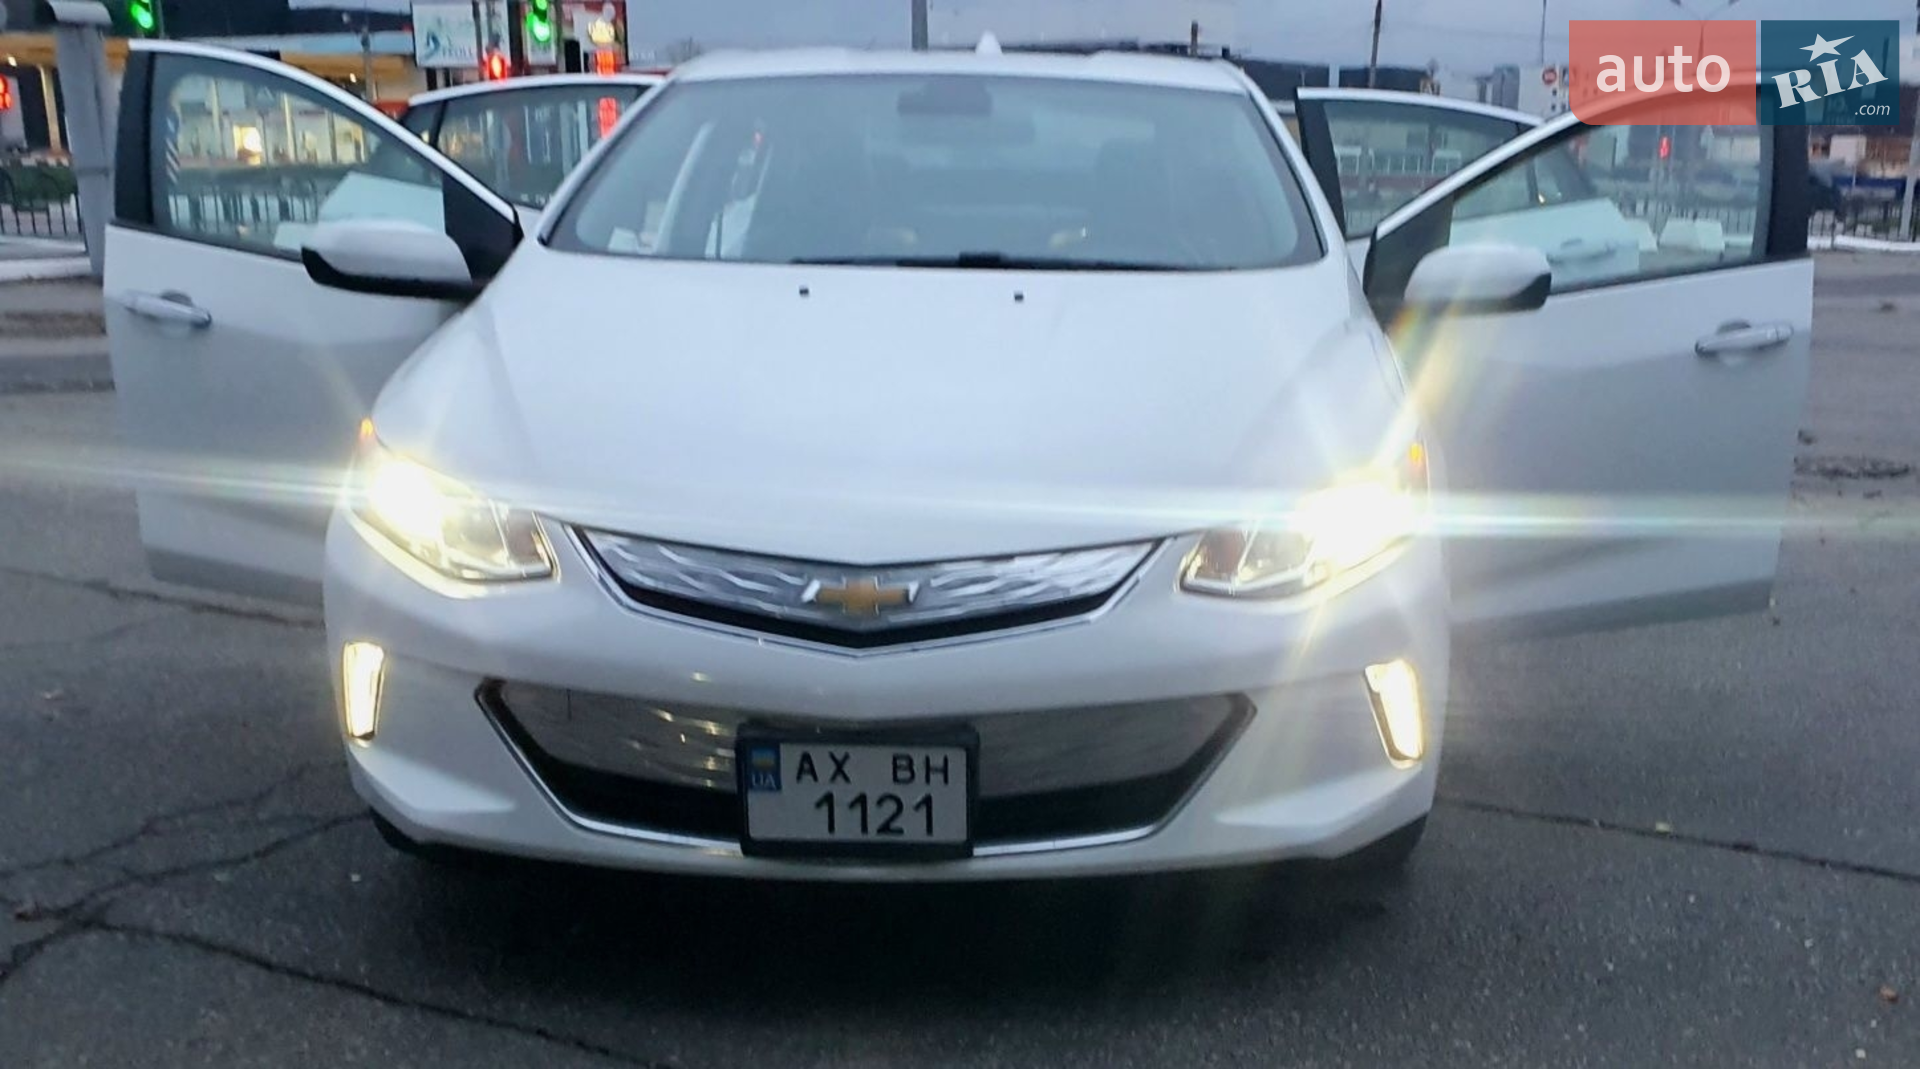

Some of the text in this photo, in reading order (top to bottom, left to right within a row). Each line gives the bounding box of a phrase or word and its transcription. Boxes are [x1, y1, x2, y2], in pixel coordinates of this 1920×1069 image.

[751, 773, 776, 788] UA
[796, 751, 949, 786] AX BH
[814, 791, 934, 837] 1121
